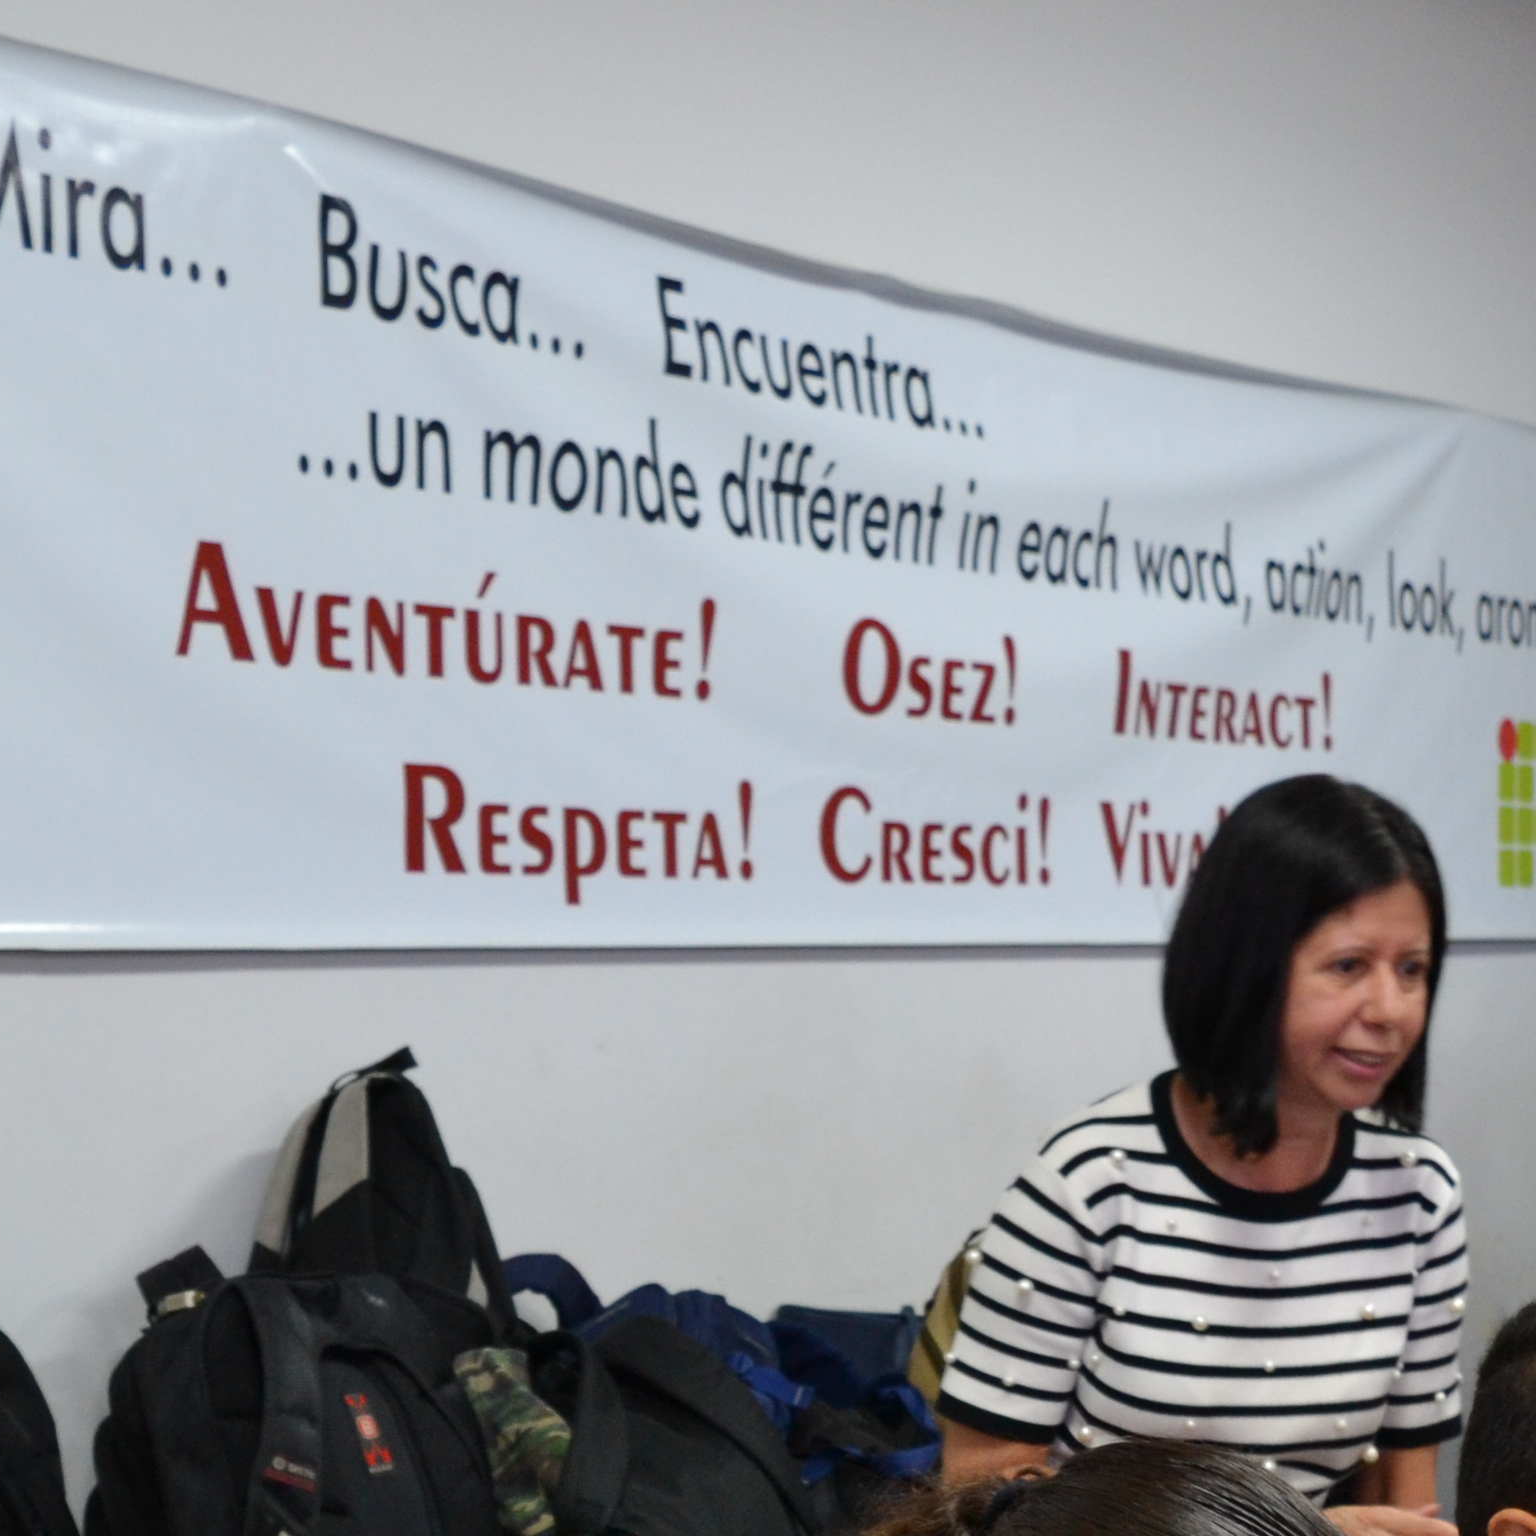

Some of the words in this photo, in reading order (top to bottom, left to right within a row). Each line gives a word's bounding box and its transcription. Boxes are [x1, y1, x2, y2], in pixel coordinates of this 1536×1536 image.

[318, 193, 585, 359] Busca...
[656, 275, 984, 439] Encuentra...
[483, 418, 702, 530] monde
[720, 434, 945, 566] différent
[958, 479, 1001, 575] in
[1016, 500, 1120, 592] each
[1135, 522, 1252, 624] word,
[1266, 541, 1374, 642] action,
[1387, 550, 1462, 652] look,
